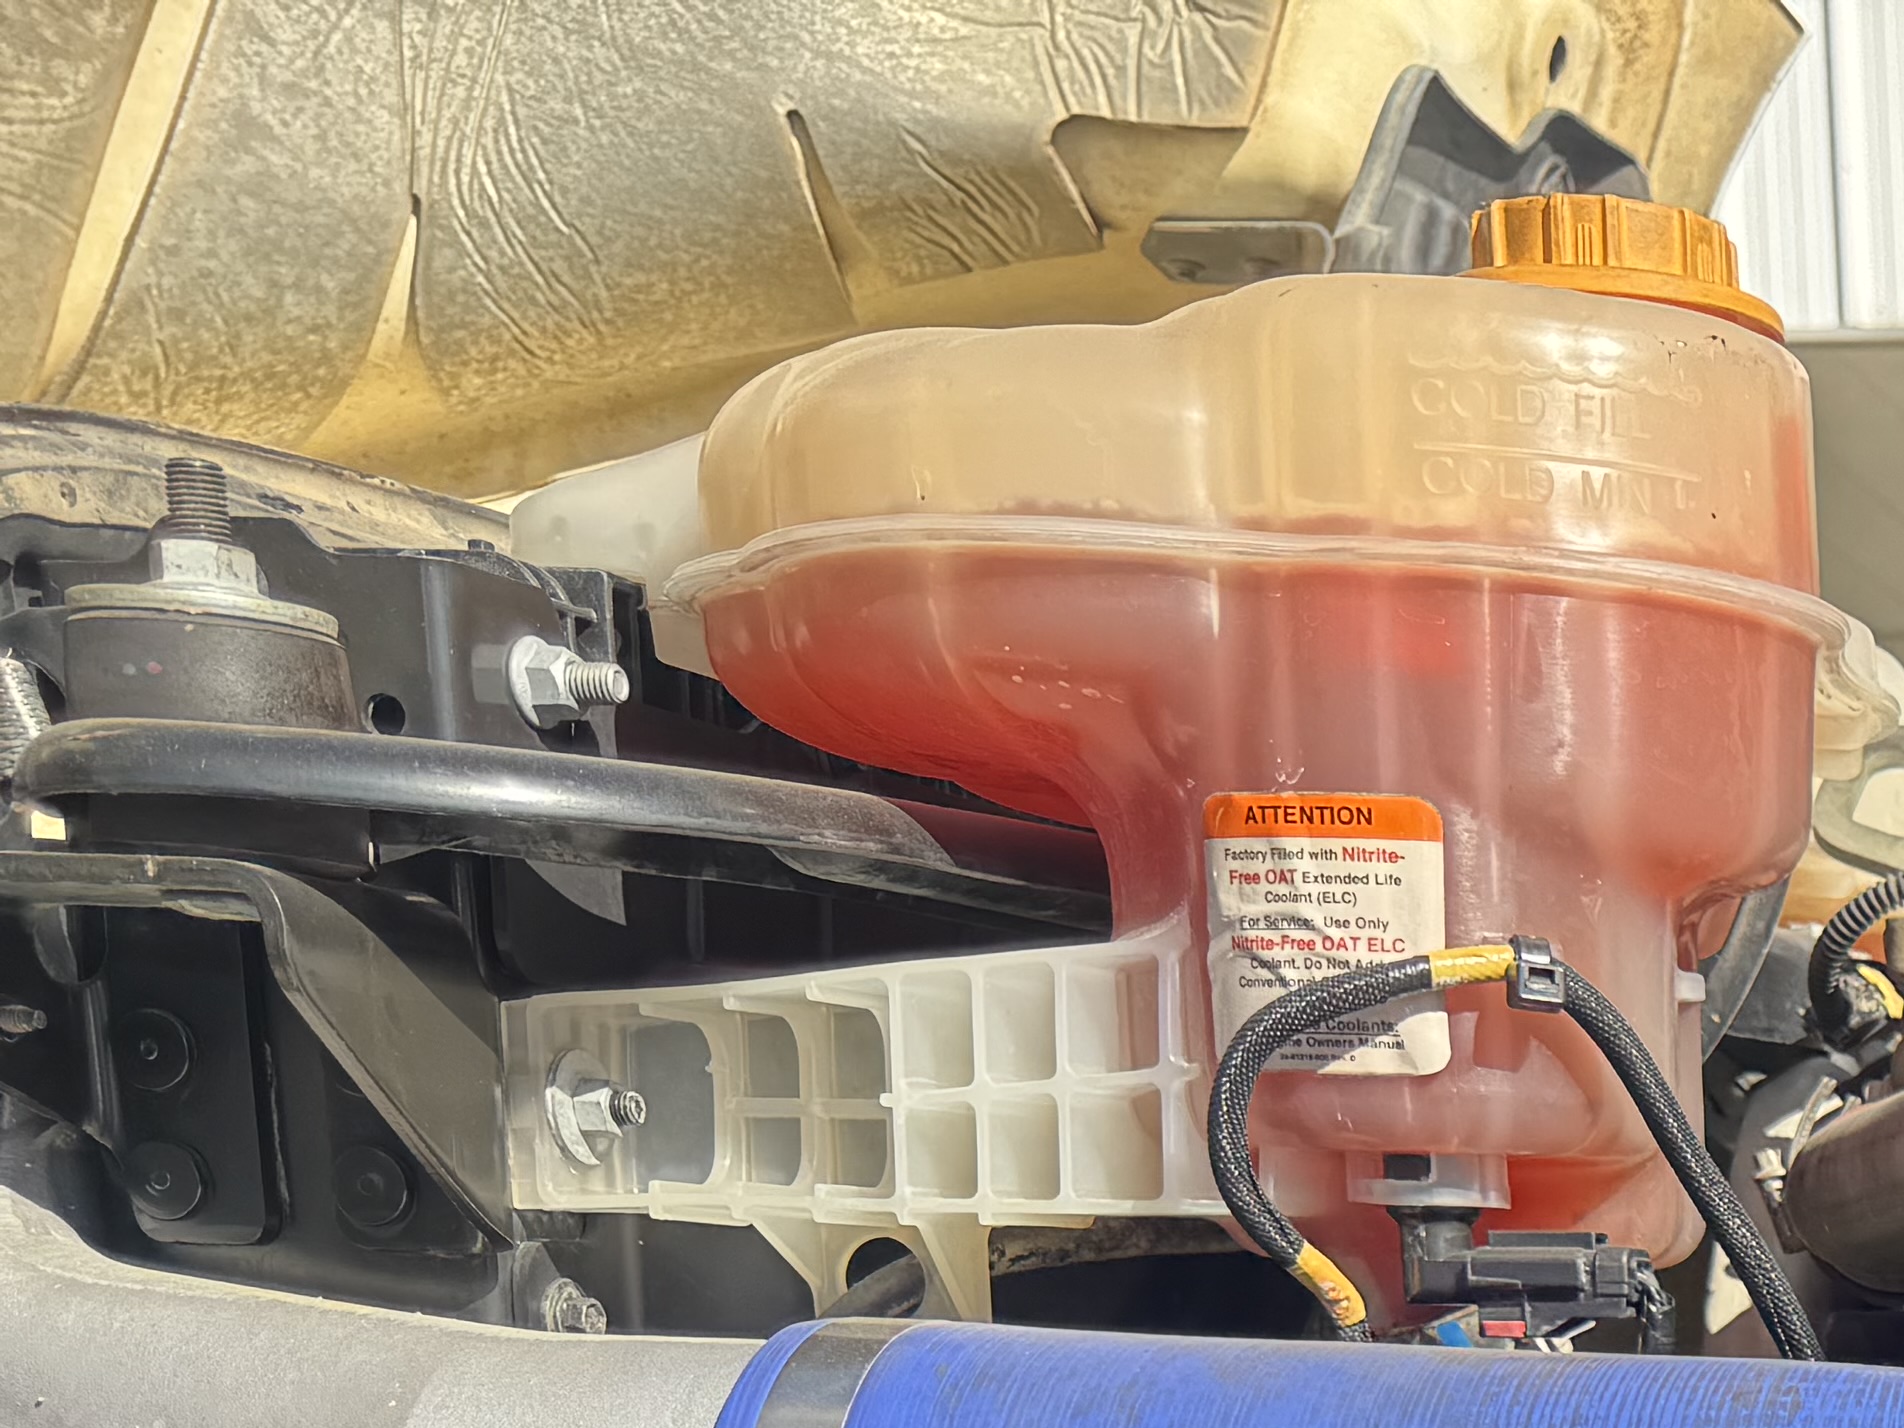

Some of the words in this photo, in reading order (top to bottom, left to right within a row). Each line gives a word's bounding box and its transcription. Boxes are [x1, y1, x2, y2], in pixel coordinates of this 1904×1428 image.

[1421, 456, 1555, 503] COLD
[1244, 806, 1374, 826] ATTENTION
[1224, 848, 1267, 863] Factory
[1270, 847, 1304, 861] Filled
[1308, 848, 1338, 861] with
[1341, 846, 1406, 863] Nitrite-
[1229, 869, 1261, 886] Free
[1265, 869, 1297, 885] OAT
[1302, 873, 1370, 886] Extended
[1374, 873, 1402, 886] Life
[1264, 891, 1313, 904] Coolant
[1316, 891, 1357, 907] (ELC)
[1240, 916, 1261, 929] For
[1263, 916, 1315, 930] Service:
[1323, 917, 1350, 930] Use
[1355, 917, 1389, 933] Only
[1231, 935, 1317, 952] Nitrite-Free
[1321, 938, 1361, 952] OAT
[1367, 938, 1406, 953] ELC
[1304, 958, 1323, 970] Do
[1326, 958, 1351, 970] Not
[1306, 1037, 1355, 1049] Owners
[1359, 1037, 1405, 1050] Manual
